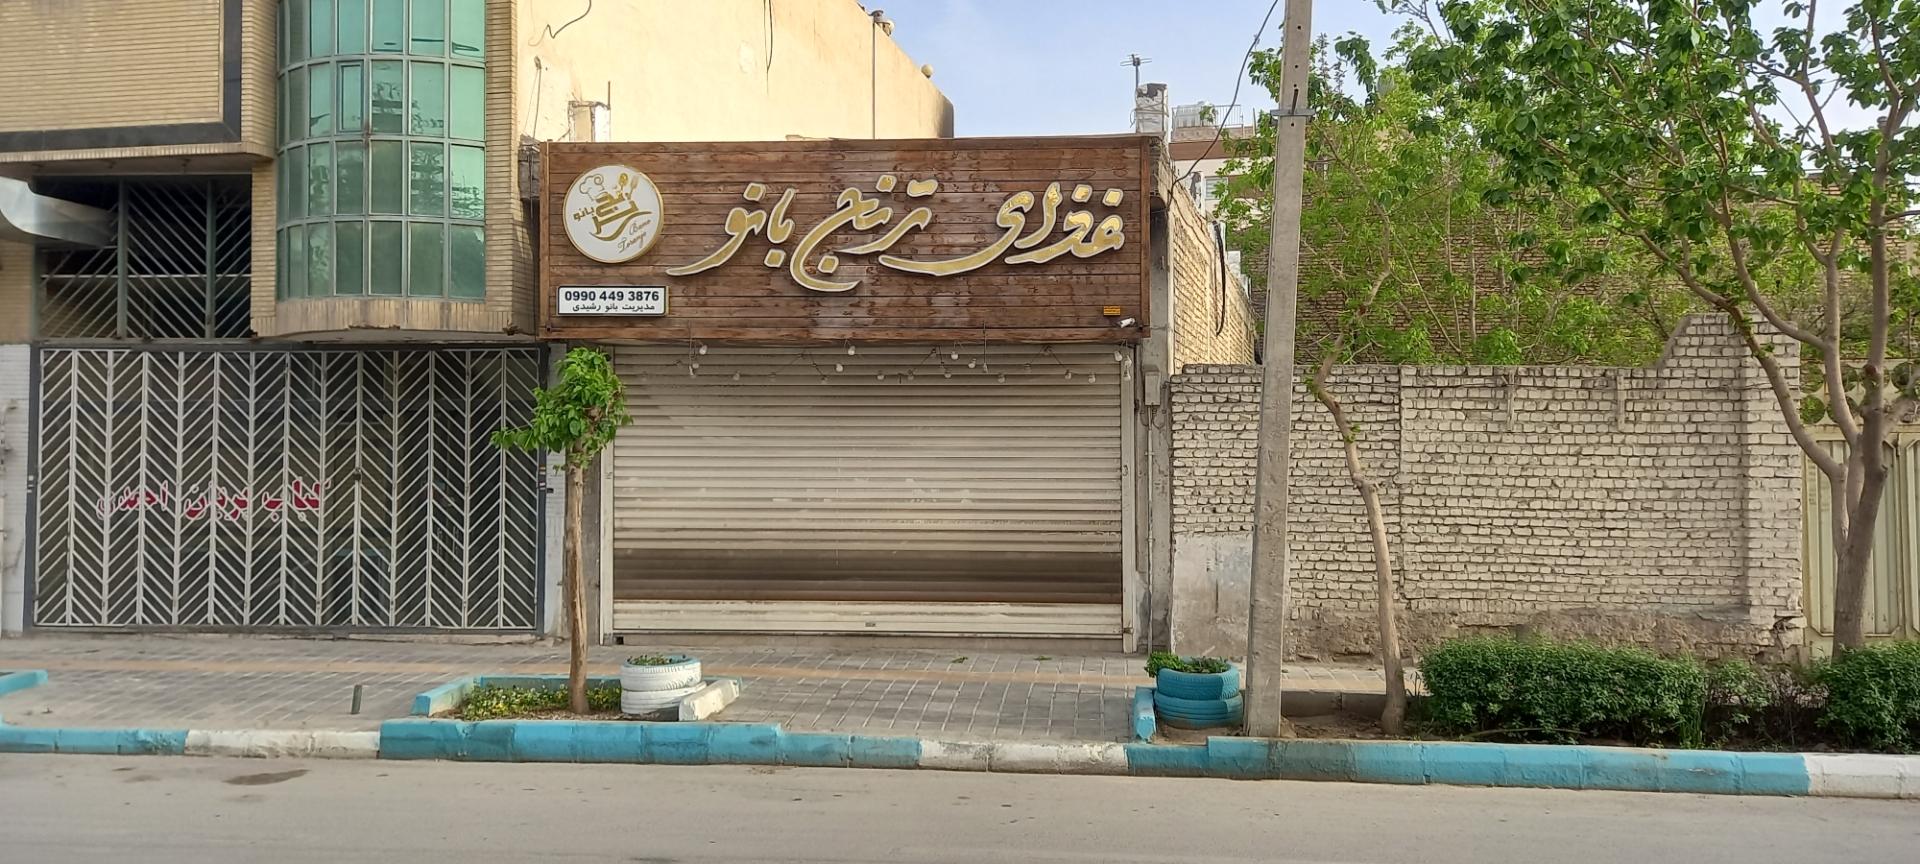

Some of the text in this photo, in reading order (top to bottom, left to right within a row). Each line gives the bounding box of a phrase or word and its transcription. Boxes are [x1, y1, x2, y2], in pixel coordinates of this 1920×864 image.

[573, 206, 595, 221] بانو
[665, 174, 1124, 292] غذای ترنج بانو
[565, 290, 659, 301] 0990 449 3876
[572, 302, 655, 312] مدیریت بانو رشیدی
[262, 478, 331, 522] کباب
